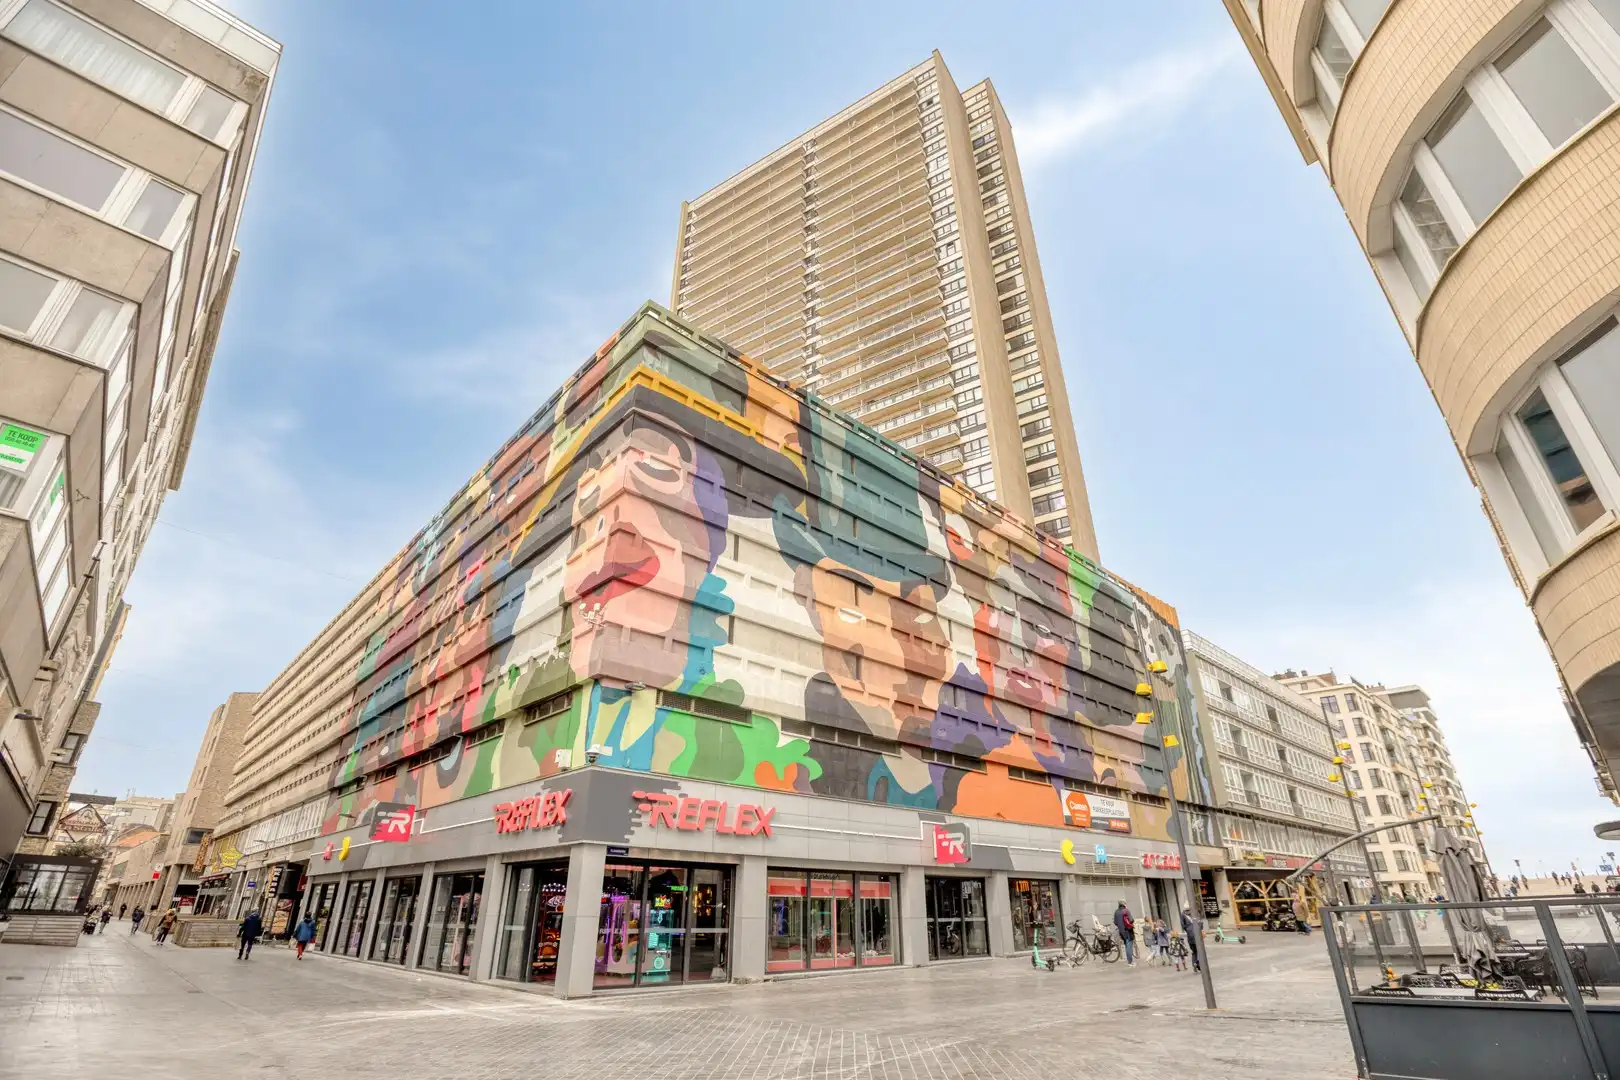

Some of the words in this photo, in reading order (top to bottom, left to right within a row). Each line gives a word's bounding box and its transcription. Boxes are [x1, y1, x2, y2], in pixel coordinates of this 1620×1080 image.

[8, 430, 18, 438] TE
[17, 432, 39, 443] KOOP
[494, 788, 573, 833] REFLEX
[632, 790, 776, 838] REFLEX
